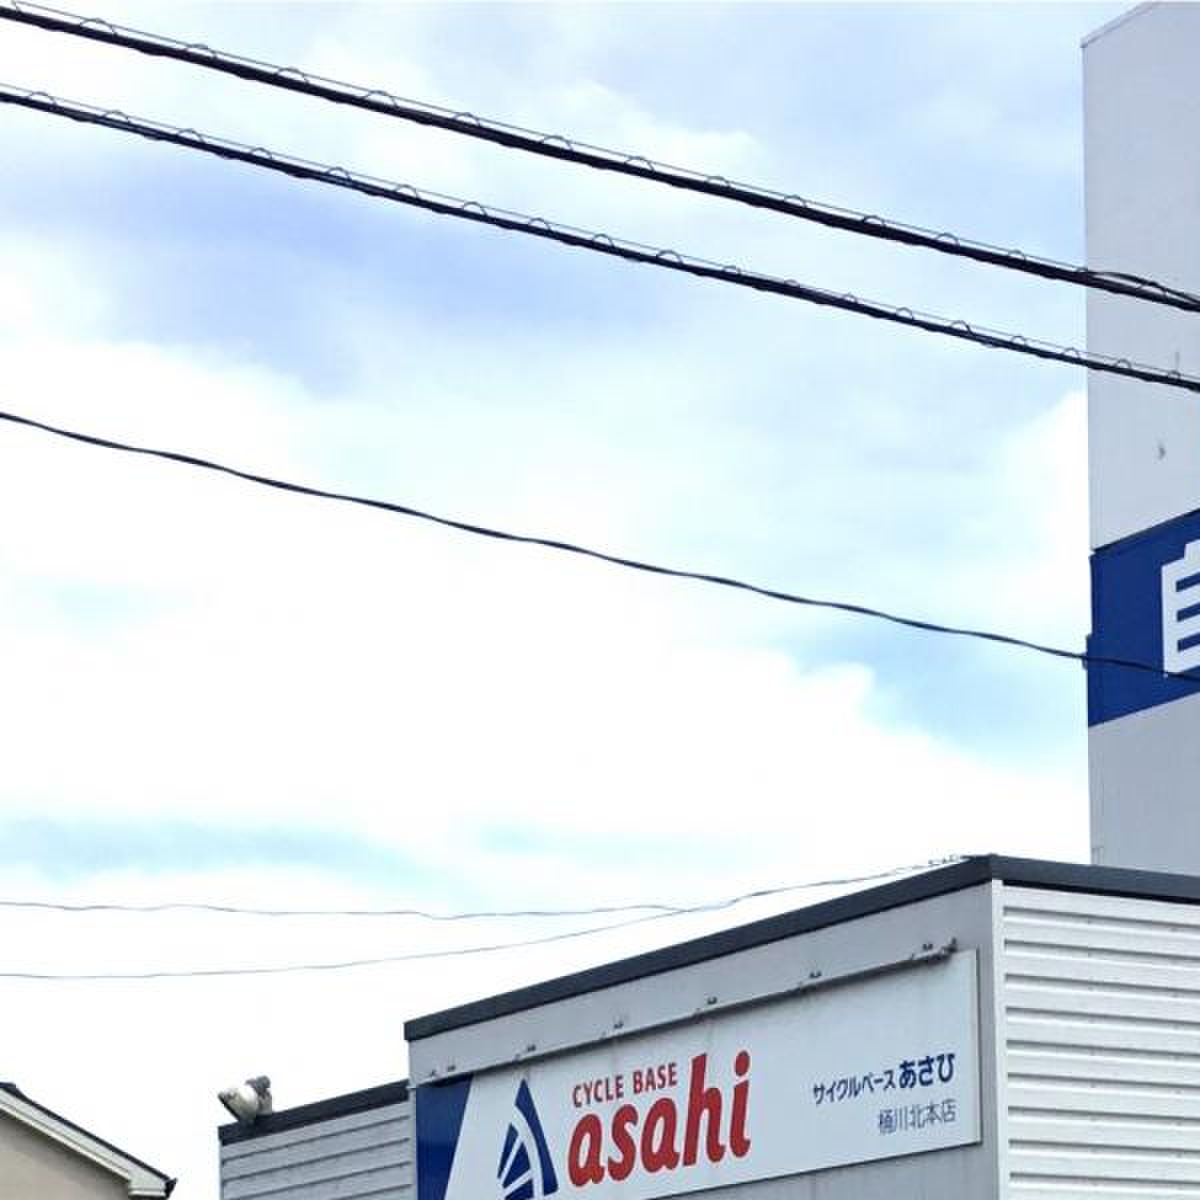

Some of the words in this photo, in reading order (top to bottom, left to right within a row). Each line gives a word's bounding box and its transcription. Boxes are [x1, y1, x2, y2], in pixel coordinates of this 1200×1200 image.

[568, 1050, 751, 1187] asahi
[572, 1074, 624, 1108] CYCLE
[633, 1062, 678, 1094] BASE
